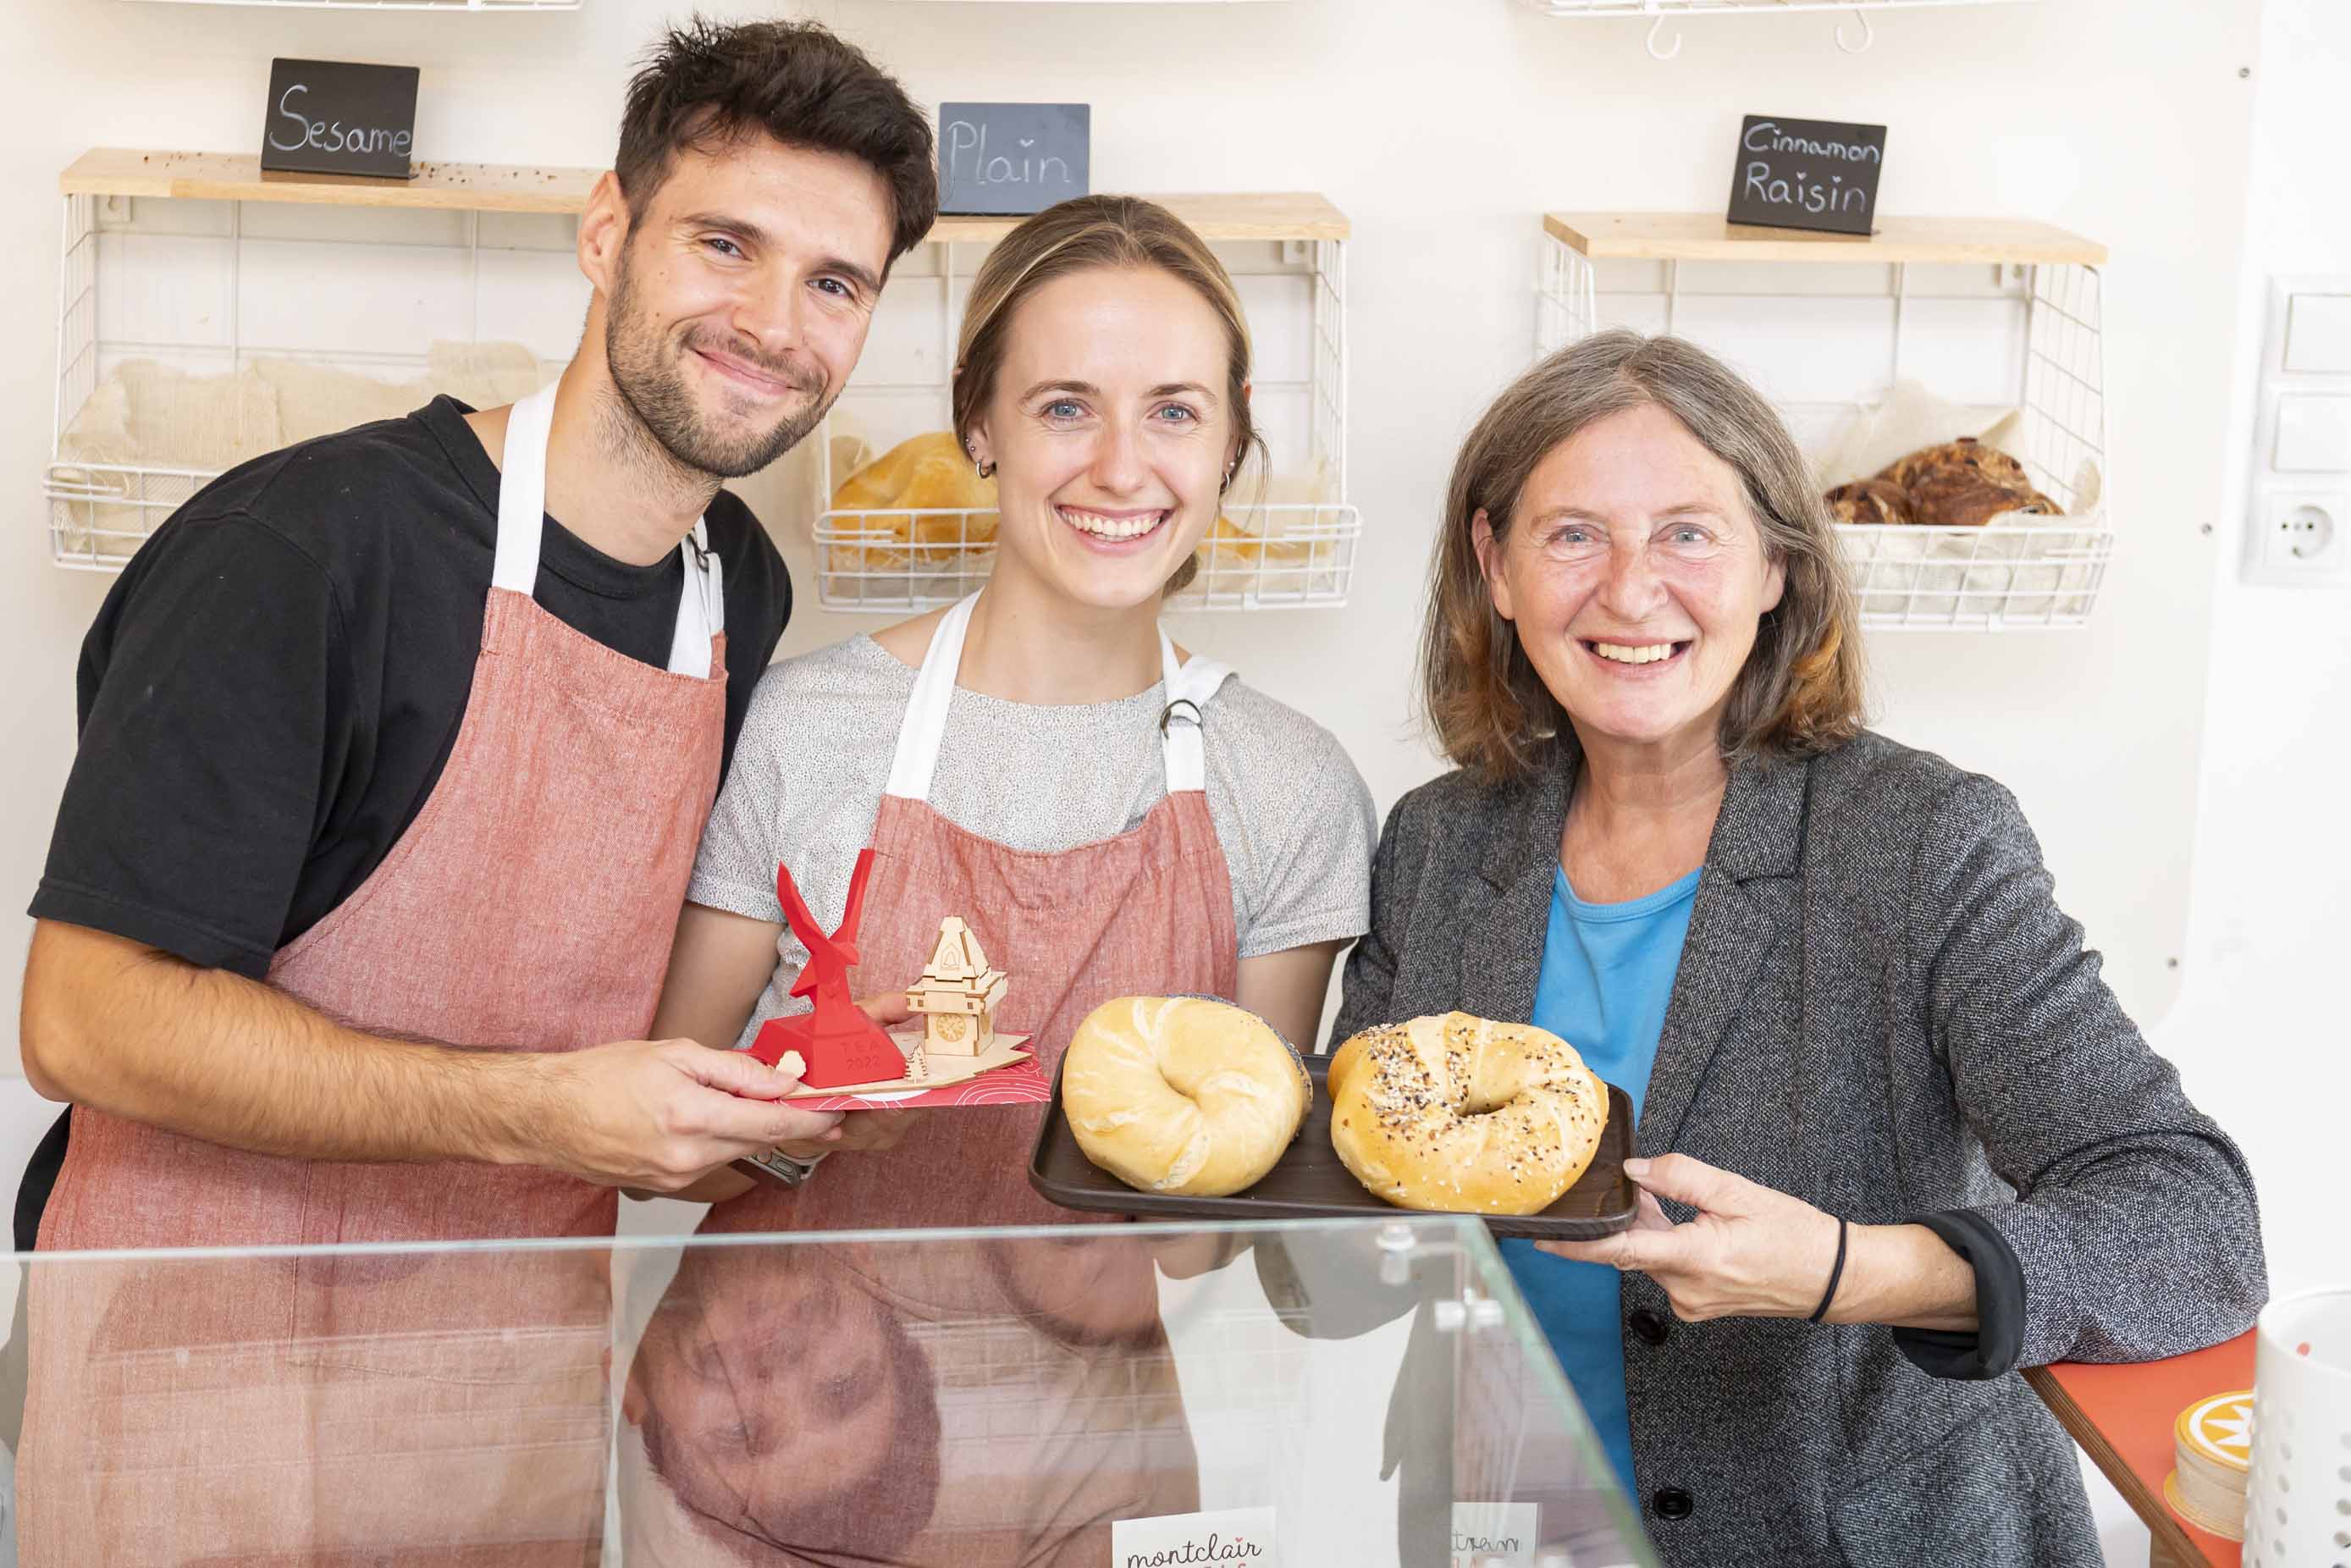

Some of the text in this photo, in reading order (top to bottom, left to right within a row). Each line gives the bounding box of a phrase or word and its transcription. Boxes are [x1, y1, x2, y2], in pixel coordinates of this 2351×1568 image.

[268, 84, 413, 157] Sesame
[1743, 122, 1880, 163] Cinnamon
[947, 120, 1071, 185] Plain
[1743, 161, 1867, 213] Raisin
[1127, 1532, 1263, 1568] montclair
